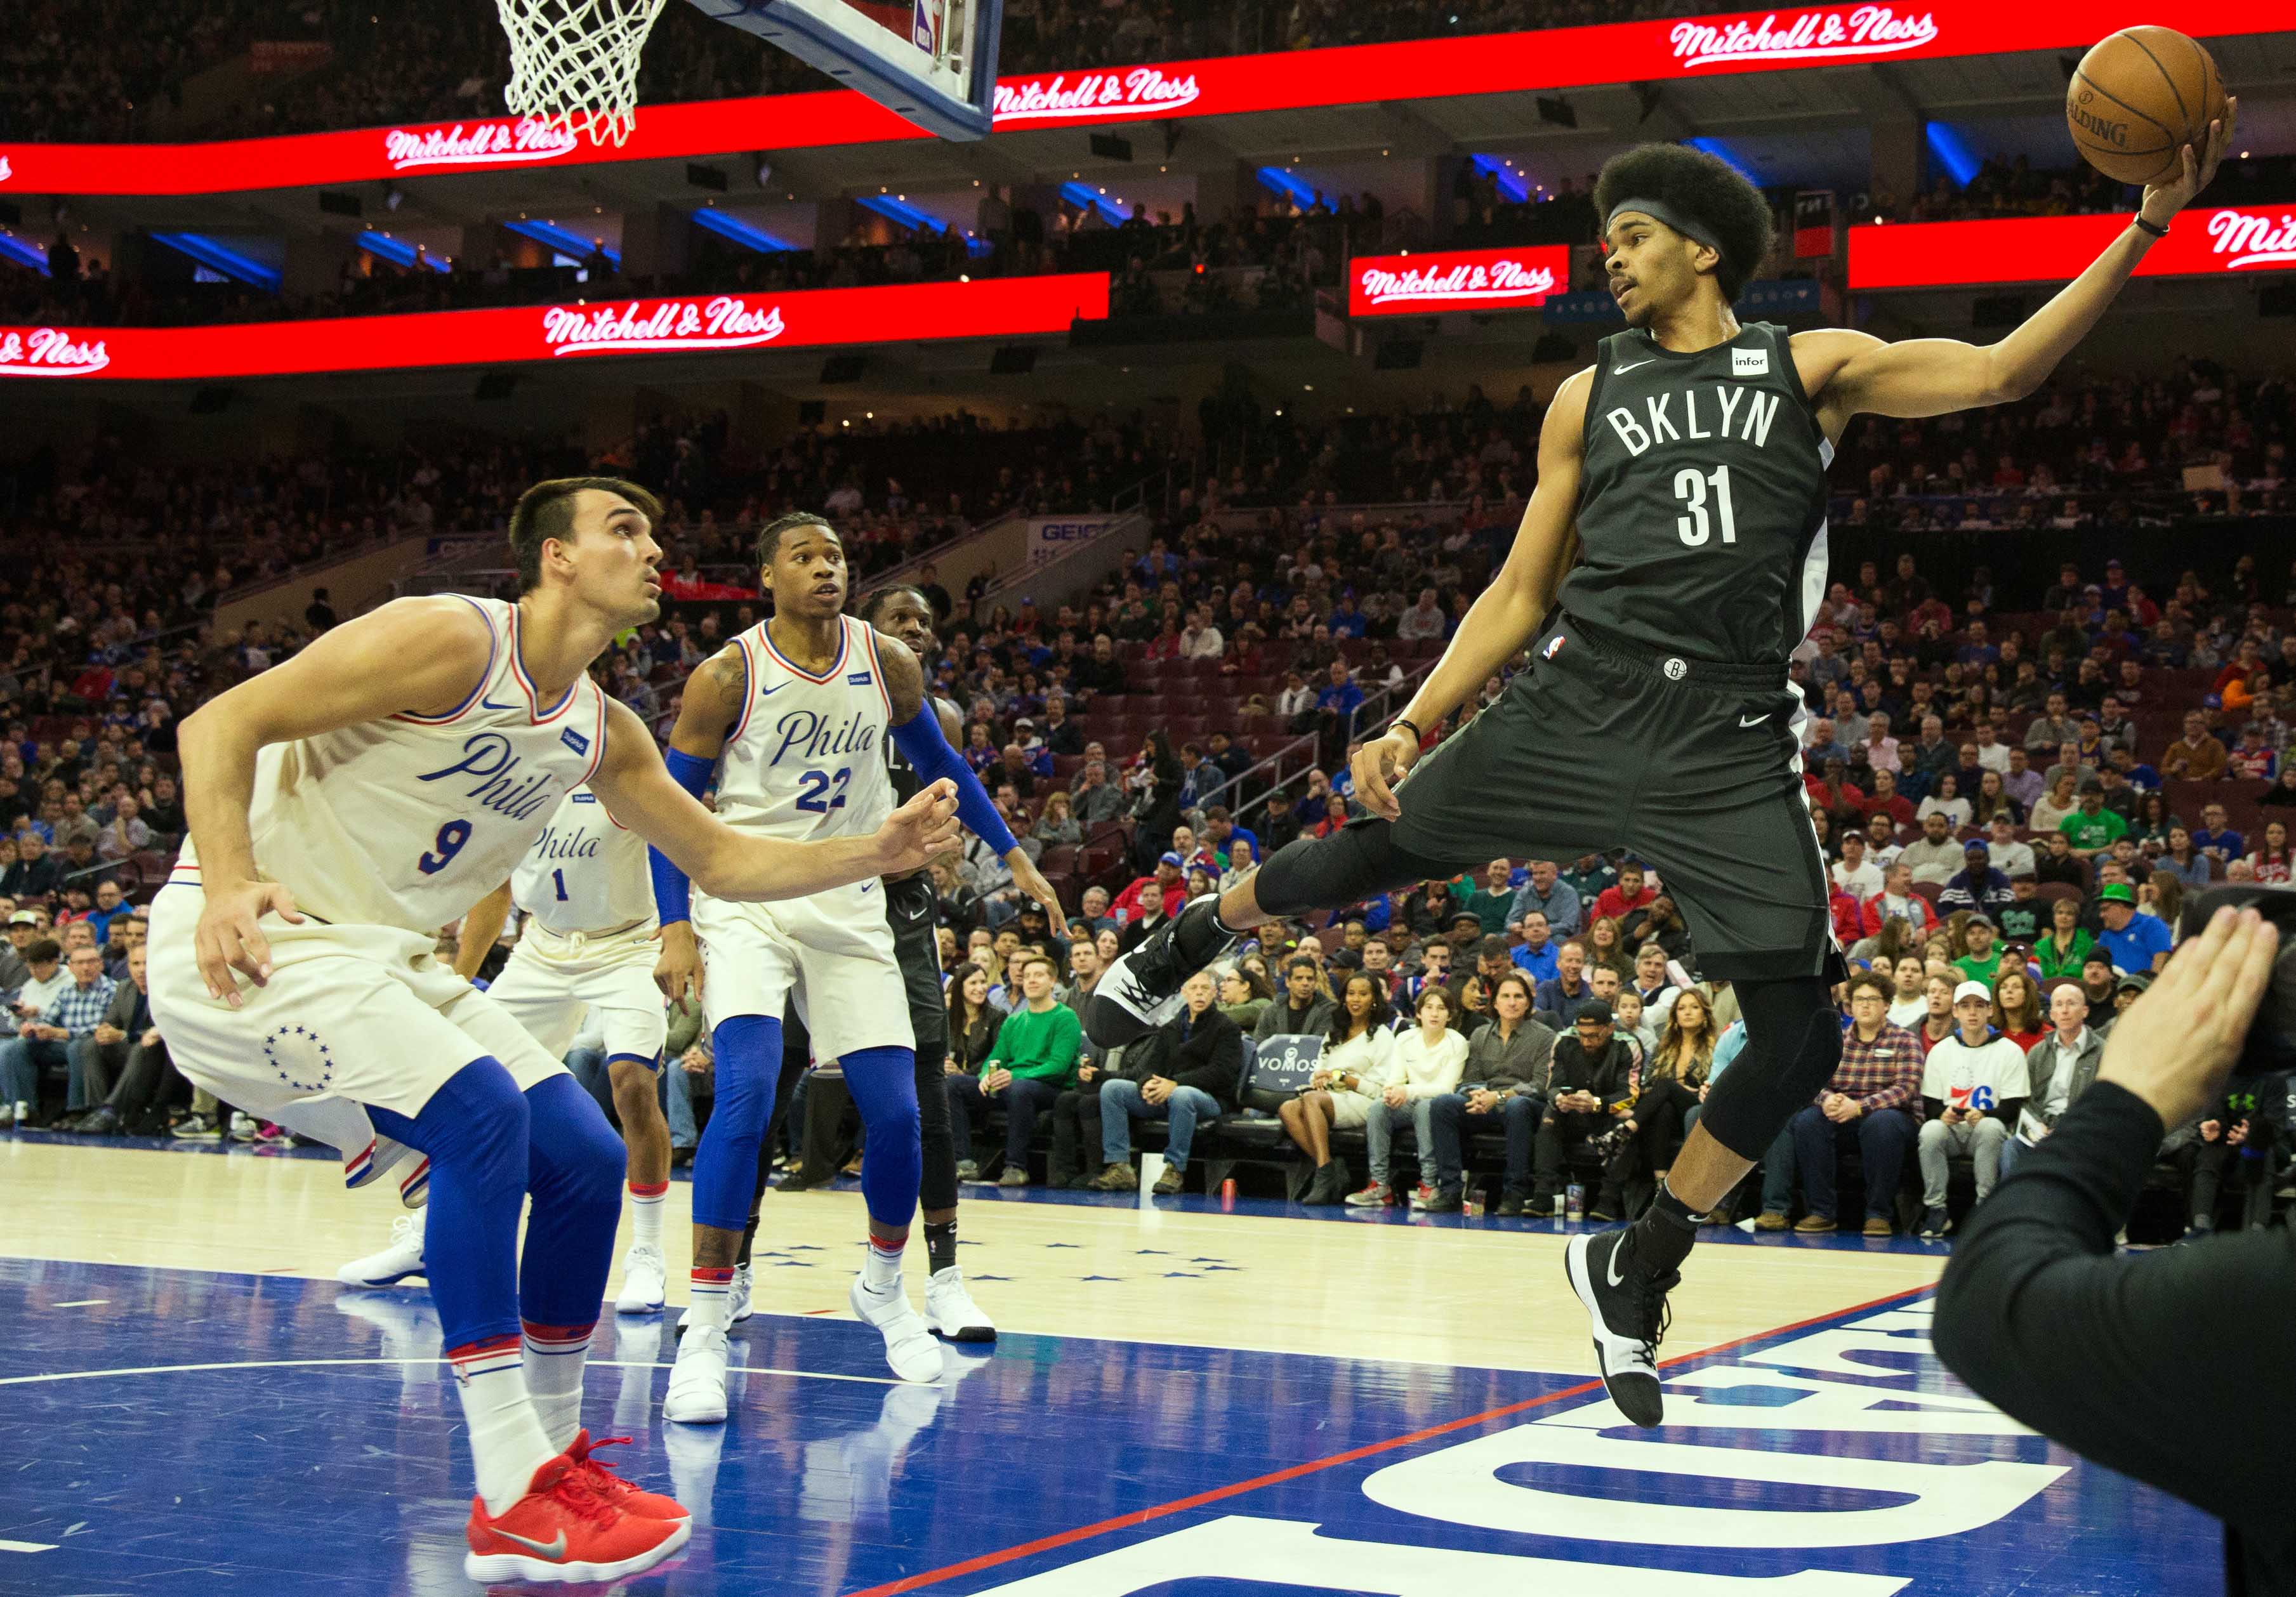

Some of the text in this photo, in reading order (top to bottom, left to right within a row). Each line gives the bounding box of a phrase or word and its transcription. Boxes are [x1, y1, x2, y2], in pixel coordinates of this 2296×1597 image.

[1670, 6, 1938, 56] Mitchell & Ness
[1099, 75, 1123, 104] &
[1125, 68, 1199, 102] Ness
[386, 119, 577, 160] Mitchell & Ness
[1362, 260, 1554, 296] Mitchell & Ness
[543, 297, 784, 343] Mitchell & Ness
[28, 327, 110, 364] Ness
[1736, 357, 1765, 365] infor
[1606, 386, 1779, 457] BKLYN
[1674, 465, 1736, 547] 31
[1042, 523, 1111, 541] GEIC
[769, 711, 876, 767] Phila
[416, 733, 551, 820] Phila
[796, 767, 851, 813] 22
[418, 818, 472, 874] 9
[552, 869, 569, 901] 1
[1950, 1086, 1994, 1110] 76
